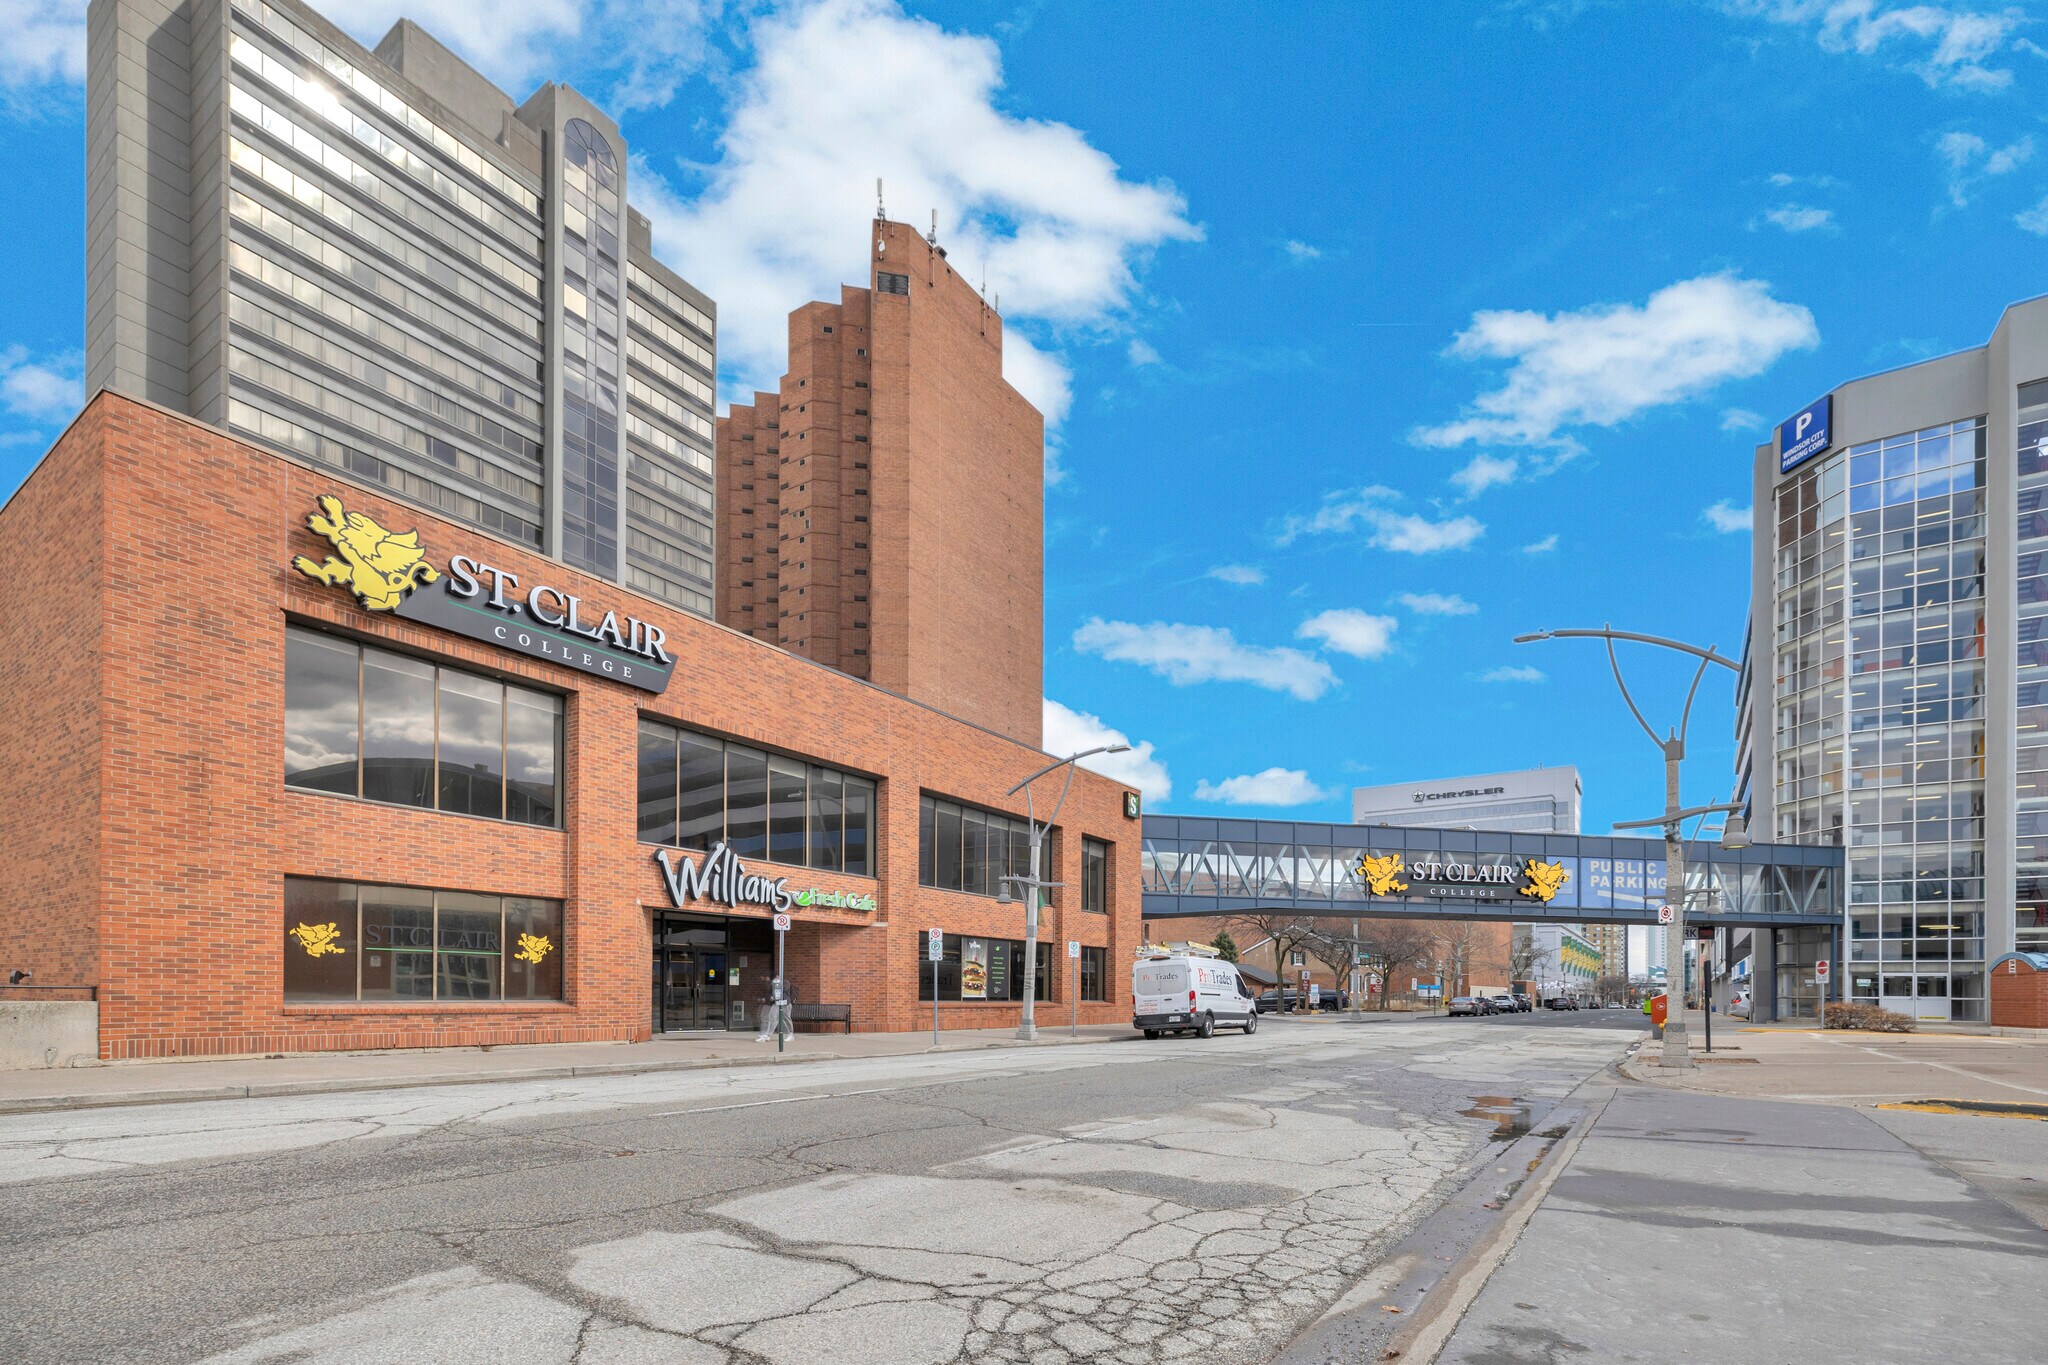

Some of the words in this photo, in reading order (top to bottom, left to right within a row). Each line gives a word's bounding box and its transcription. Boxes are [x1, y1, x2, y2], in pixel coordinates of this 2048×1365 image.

[1796, 412, 1812, 441] P
[1782, 447, 1808, 468] PARKING
[1808, 438, 1827, 453] CORP.
[1783, 437, 1810, 459] WINDSOR
[1811, 429, 1824, 442] CITY
[494, 626, 633, 678] COLLEGE
[1426, 787, 1504, 800] CHRYSLER
[653, 841, 791, 913] Williams
[1590, 860, 1657, 875] PUBLIC
[1430, 888, 1496, 897] COLLEGE
[1590, 875, 1667, 890] PARKING
[809, 887, 846, 907] Fresh
[1155, 973, 1178, 981] Trades
